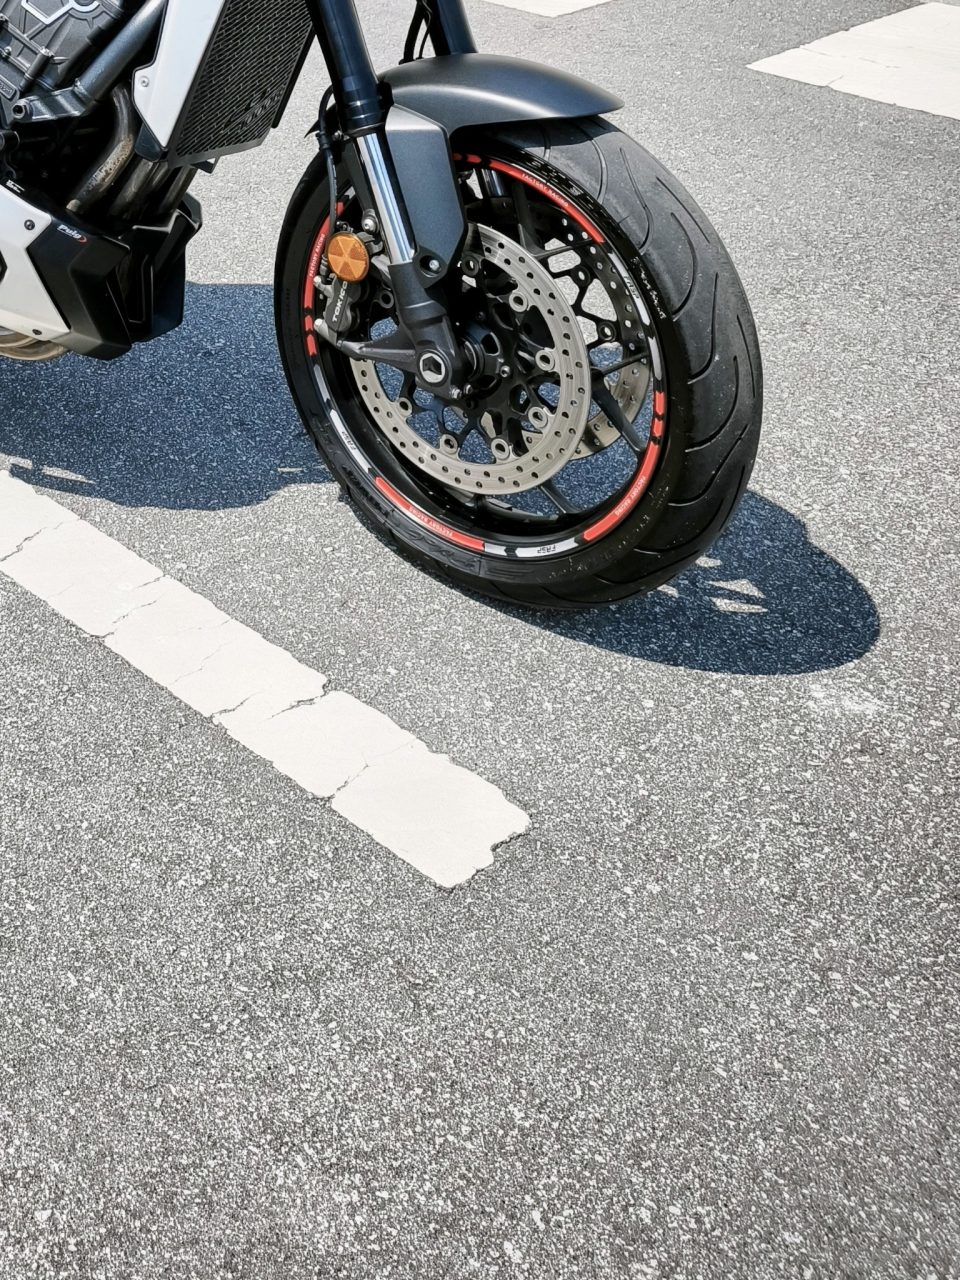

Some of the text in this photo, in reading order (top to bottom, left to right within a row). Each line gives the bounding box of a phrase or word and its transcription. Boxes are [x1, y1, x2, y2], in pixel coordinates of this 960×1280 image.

[57, 224, 82, 239] Puig
[308, 232, 325, 277] FACTORY RACING
[333, 281, 348, 322] TOKICO
[613, 474, 646, 517] FACTORY RACING
[408, 505, 453, 537] FACTORY RACING
